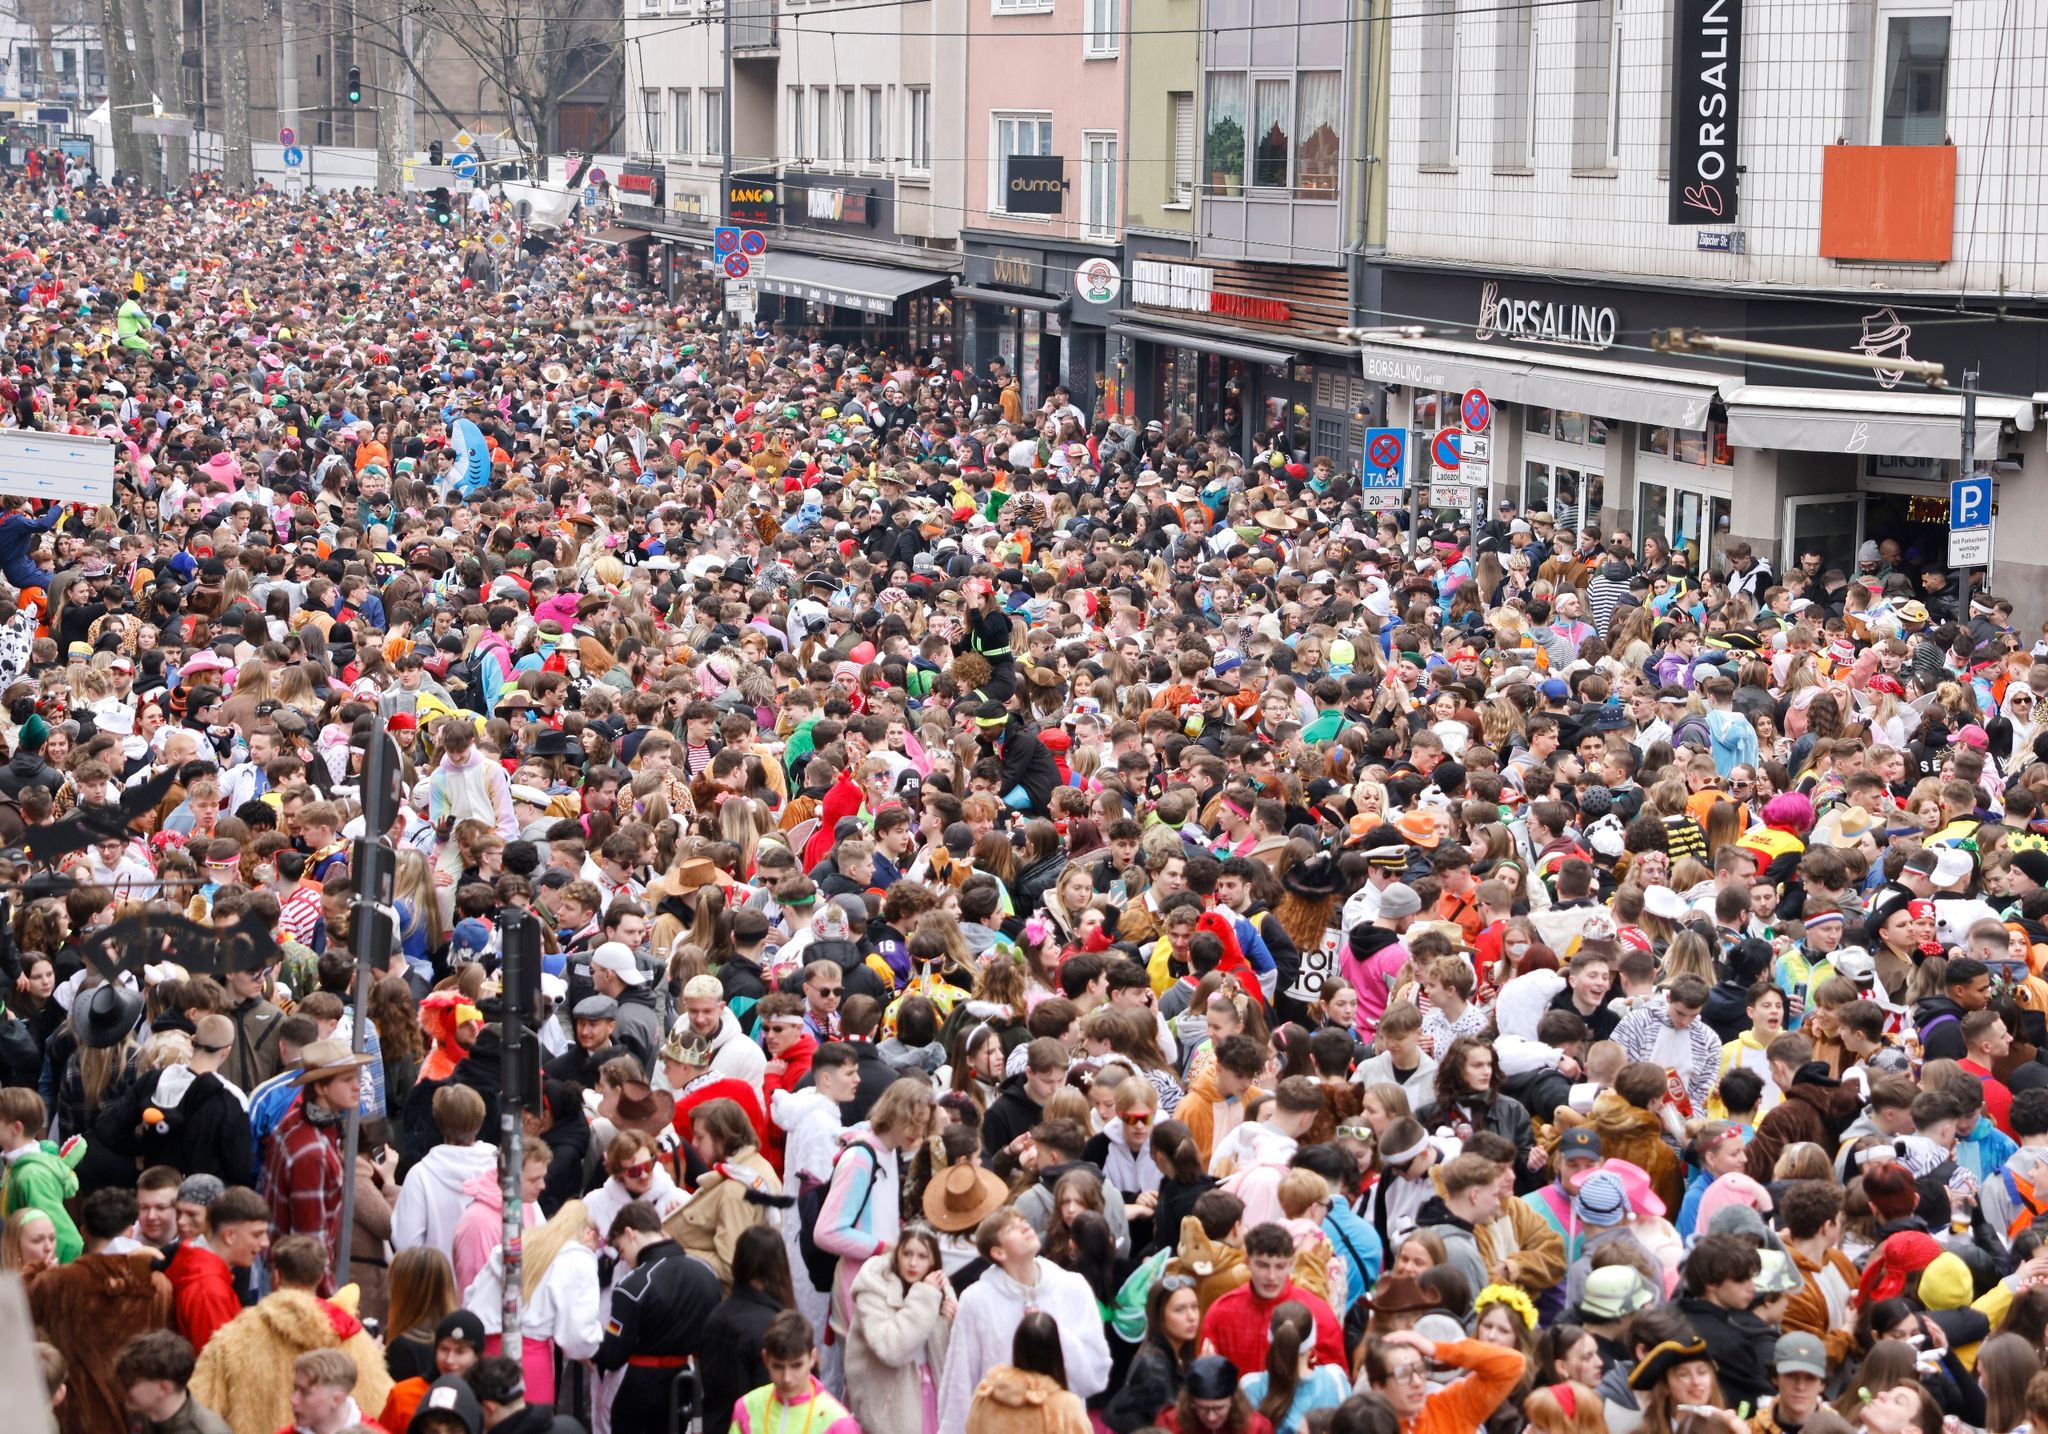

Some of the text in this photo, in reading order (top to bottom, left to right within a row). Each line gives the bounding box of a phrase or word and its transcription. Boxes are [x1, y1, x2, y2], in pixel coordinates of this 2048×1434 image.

[1683, 0, 1729, 216] BORSALIN
[1011, 177, 1061, 192] duma
[993, 250, 1032, 286] duma
[1476, 281, 1616, 349] BORSALINO
[1368, 358, 1422, 382] BORSALINO
[1436, 472, 1459, 481] Ladezo
[1920, 760, 1941, 773] SE
[906, 778, 919, 789] FBI
[879, 940, 896, 953] 18
